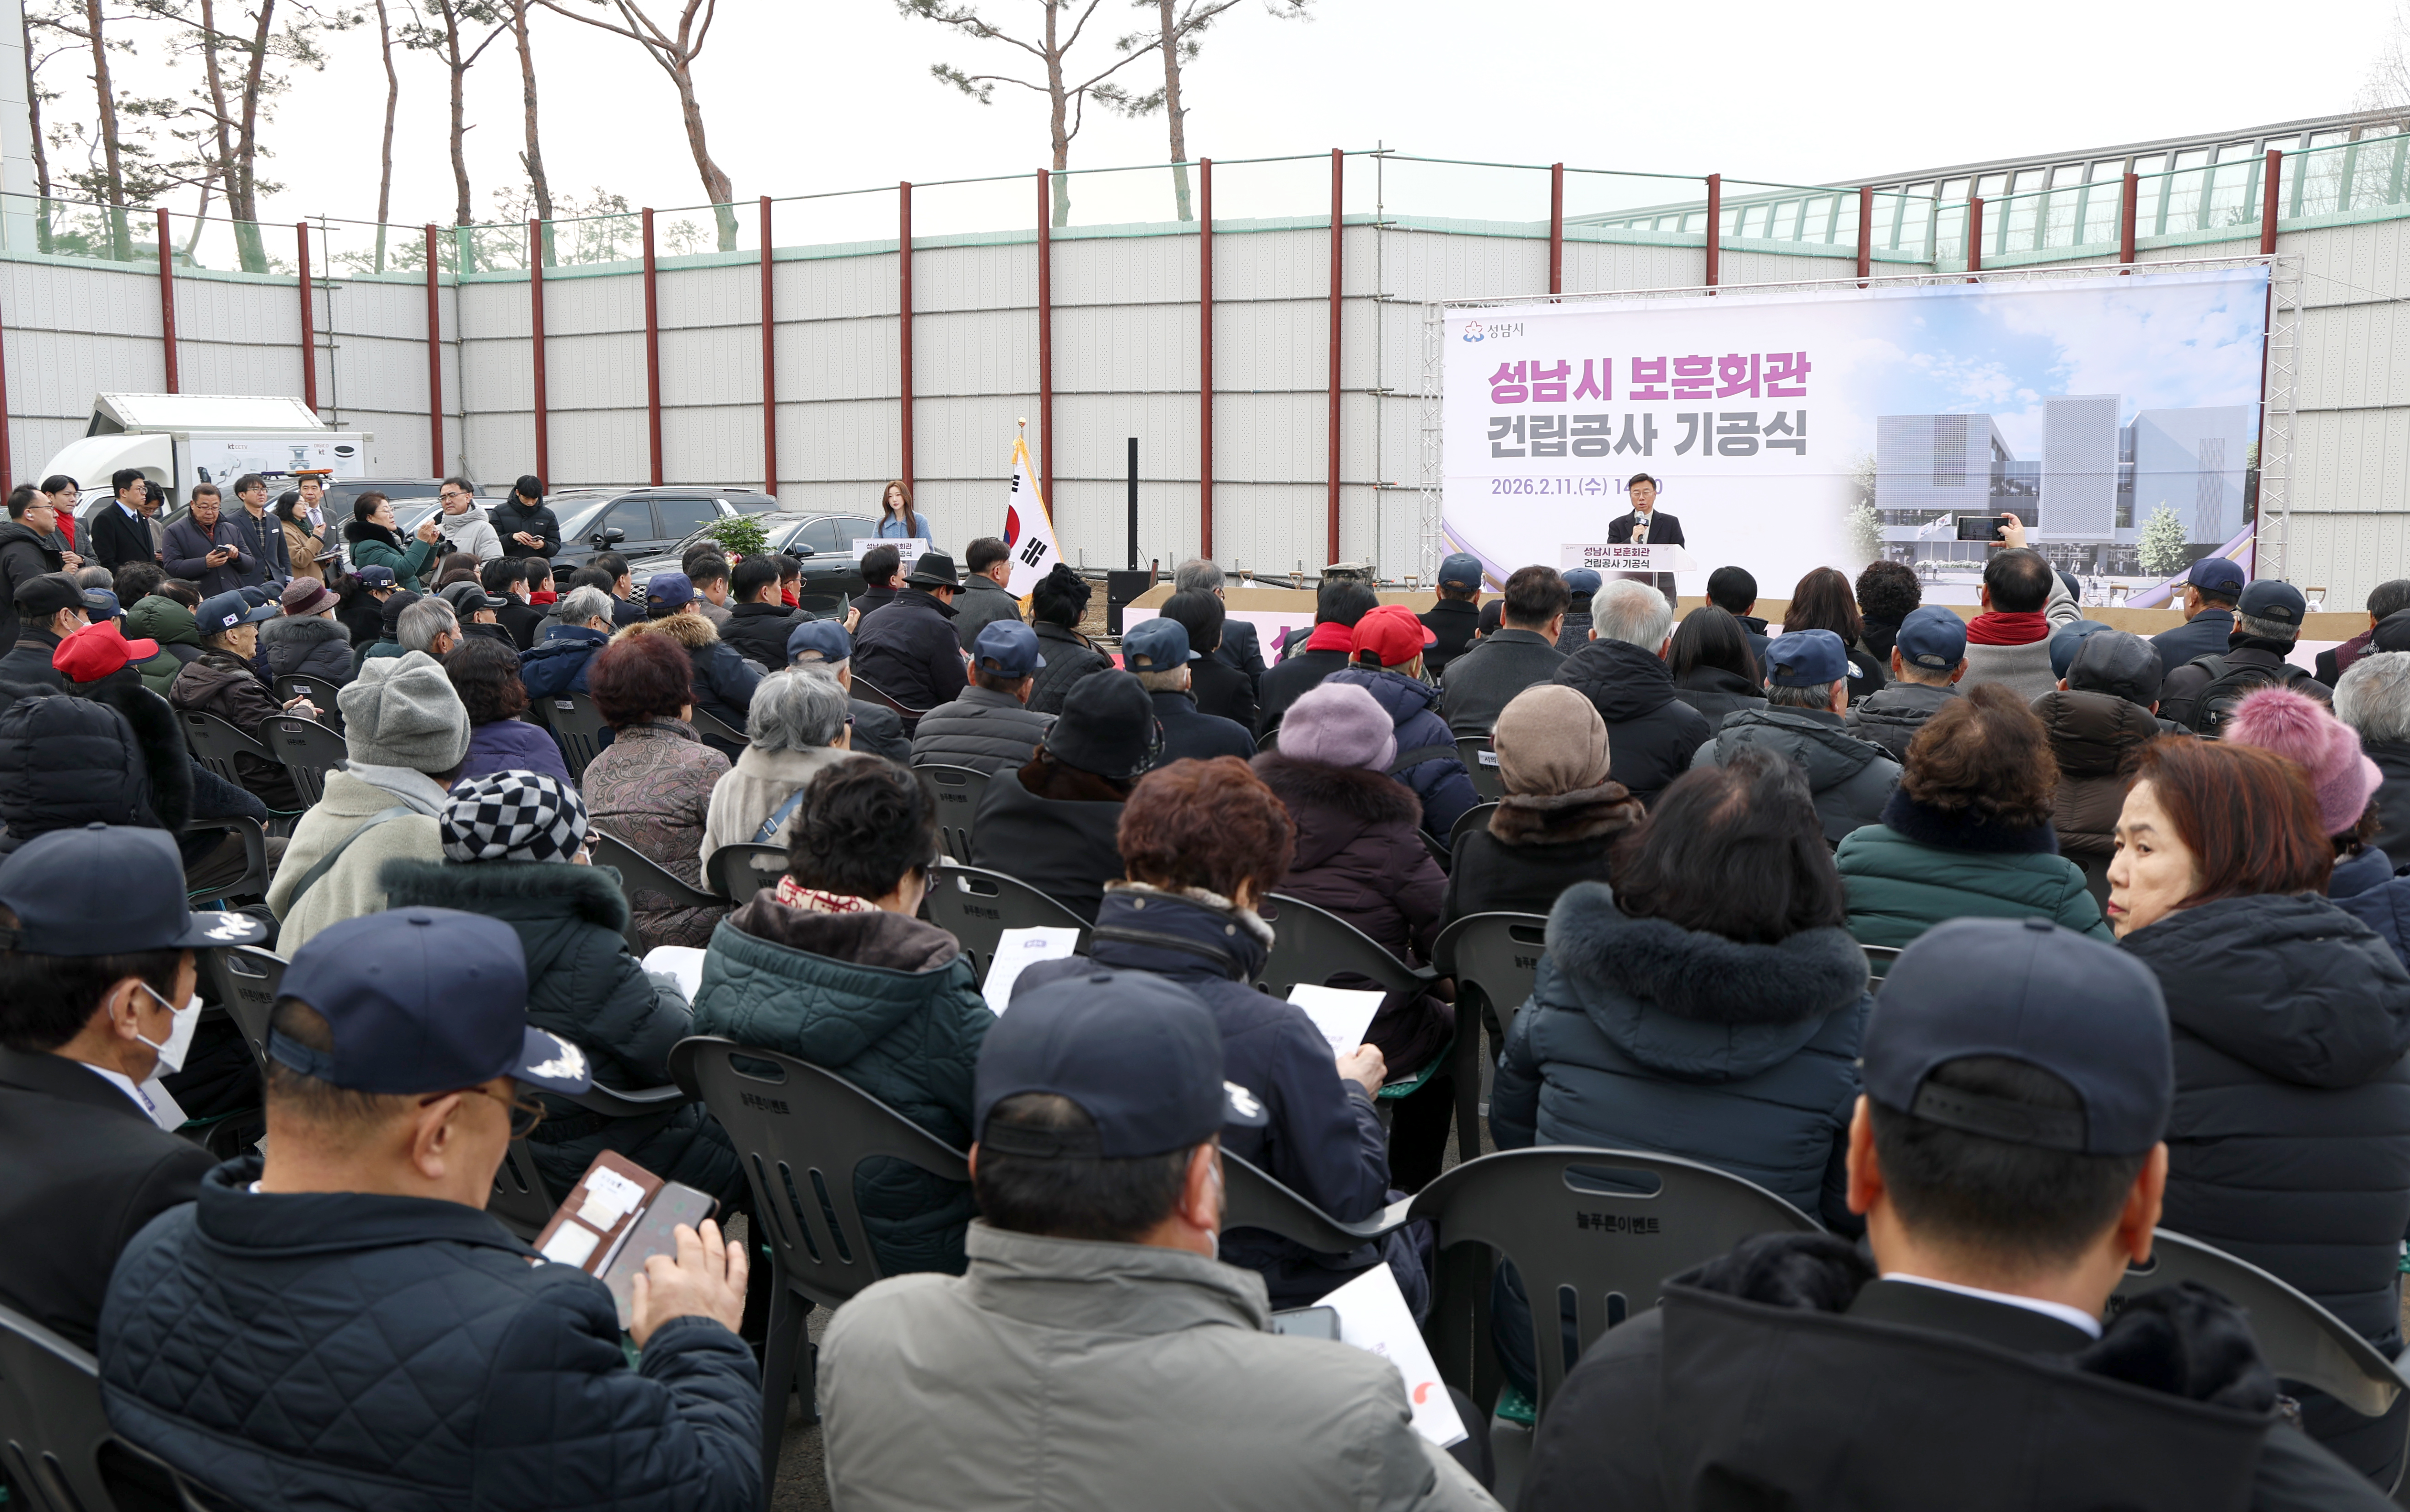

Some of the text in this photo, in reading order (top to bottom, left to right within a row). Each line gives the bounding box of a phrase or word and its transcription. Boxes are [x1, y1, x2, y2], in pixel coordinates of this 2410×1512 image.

[1487, 322, 1523, 339] 성남시
[1488, 351, 1812, 404] 성남시 보훈회관
[1487, 410, 1807, 458] 건립공사 기공식
[1491, 477, 1663, 496] 2026.2.11.(수) 140
[1584, 547, 1650, 557] 성남시 보훈회관
[1584, 558, 1650, 568] 건립공사 기공식
[940, 792, 968, 803] 늘푸른이벤트
[963, 903, 1000, 920] 늘푸른이벤트
[237, 986, 273, 1004] 늘푸른이벤트
[740, 1091, 791, 1115] 늘푸른이벤트
[1577, 1211, 1661, 1234] 늘푸른이벤트
